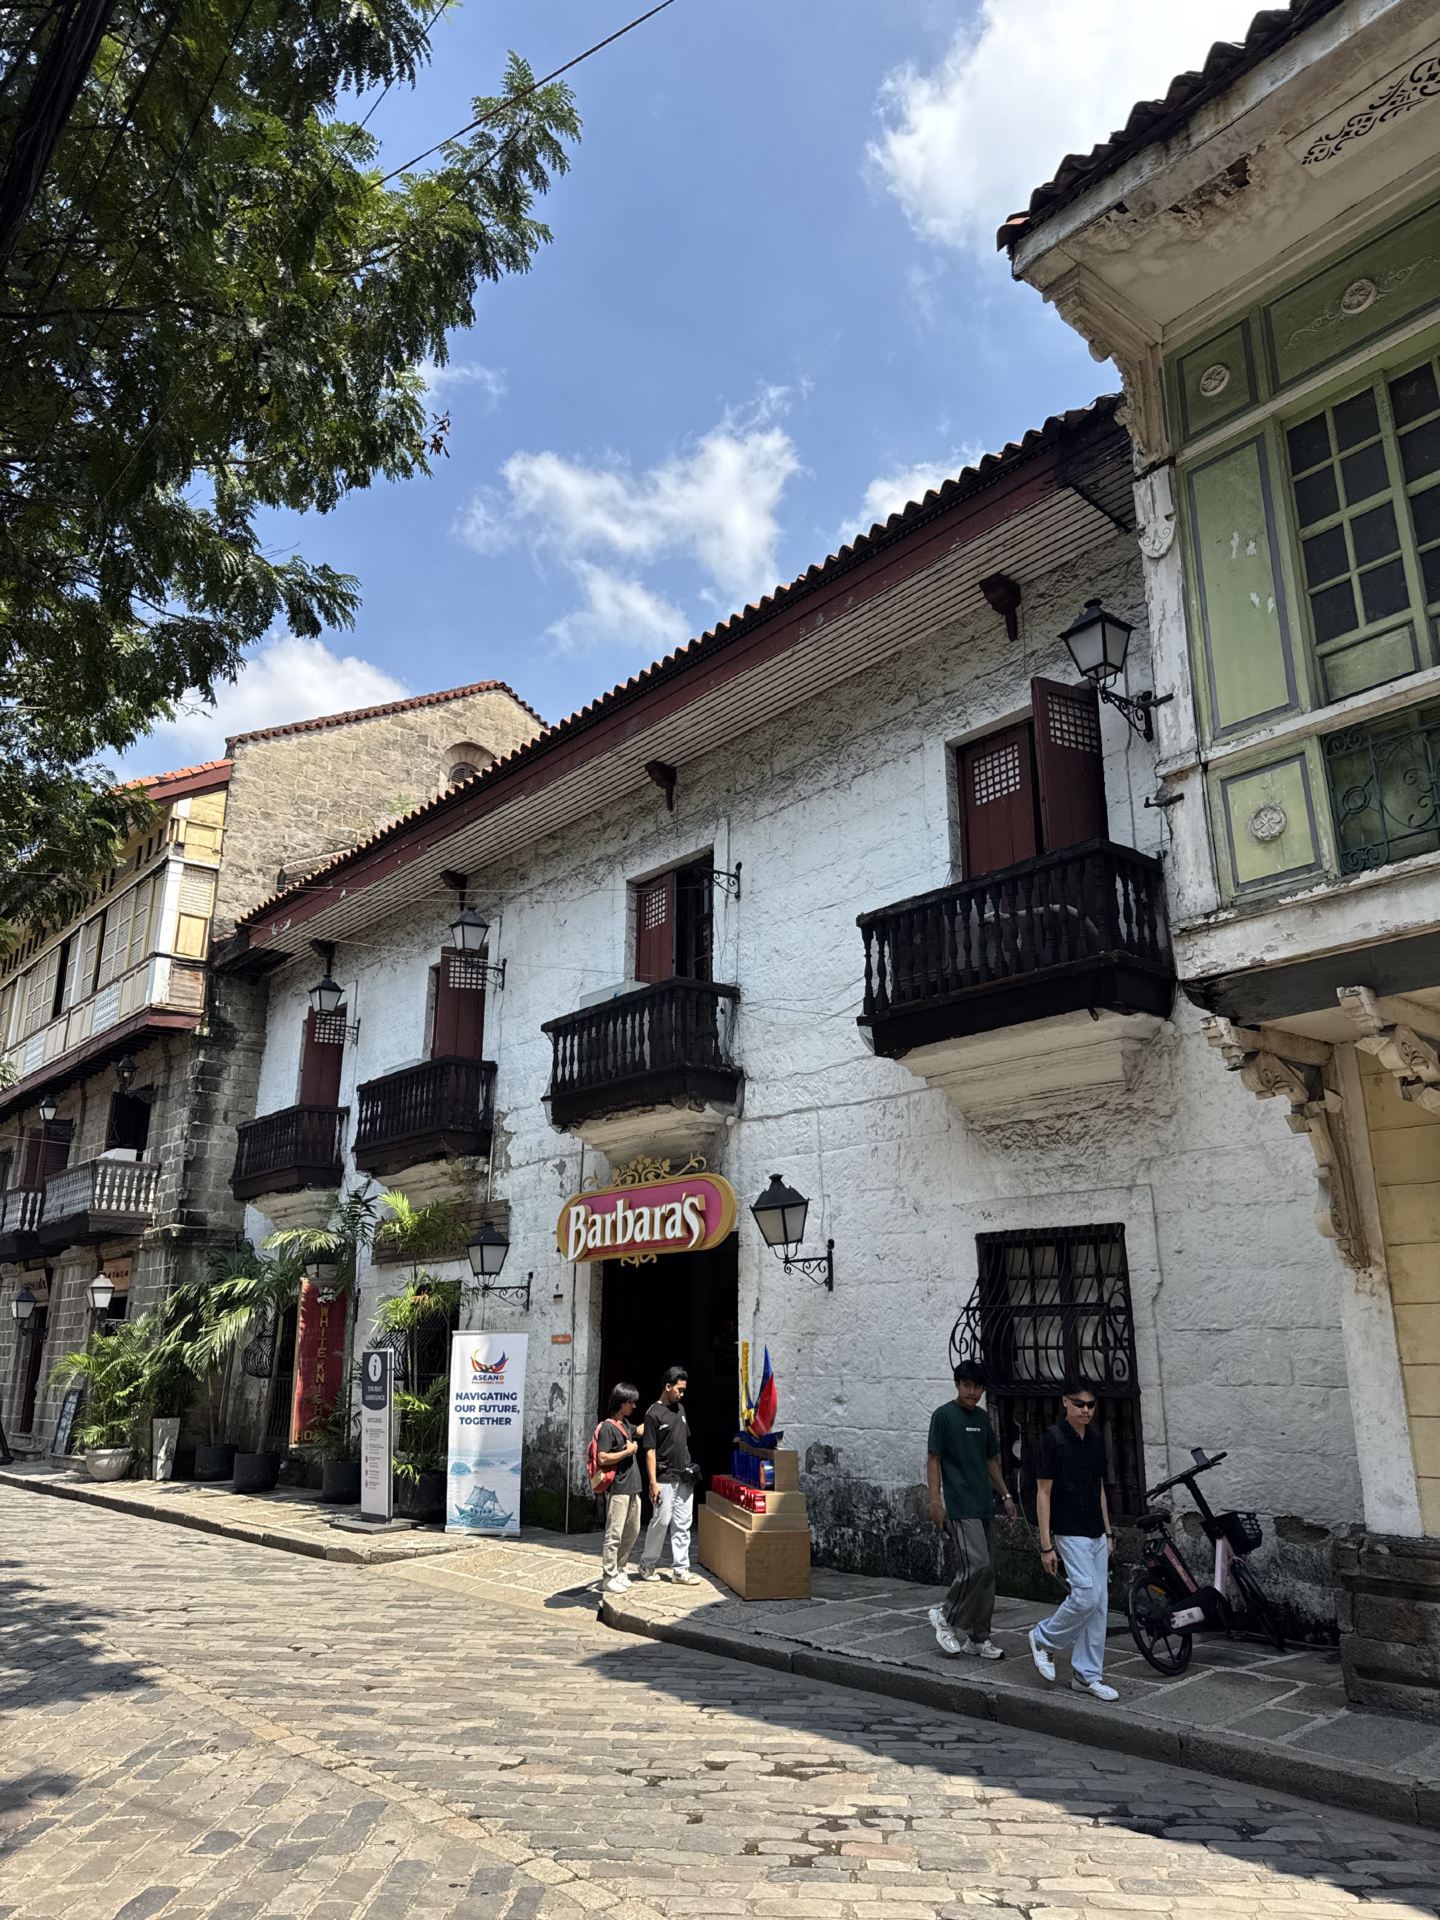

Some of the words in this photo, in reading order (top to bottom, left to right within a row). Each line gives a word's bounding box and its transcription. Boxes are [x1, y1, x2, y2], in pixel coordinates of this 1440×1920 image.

[567, 1192, 704, 1262] Barbara's
[317, 1306, 330, 1358] WHITE
[455, 1392, 518, 1401] NAVIGATING
[454, 1404, 476, 1413] OUR
[478, 1404, 521, 1415] FUTURE,
[459, 1416, 512, 1426] TOGETHER
